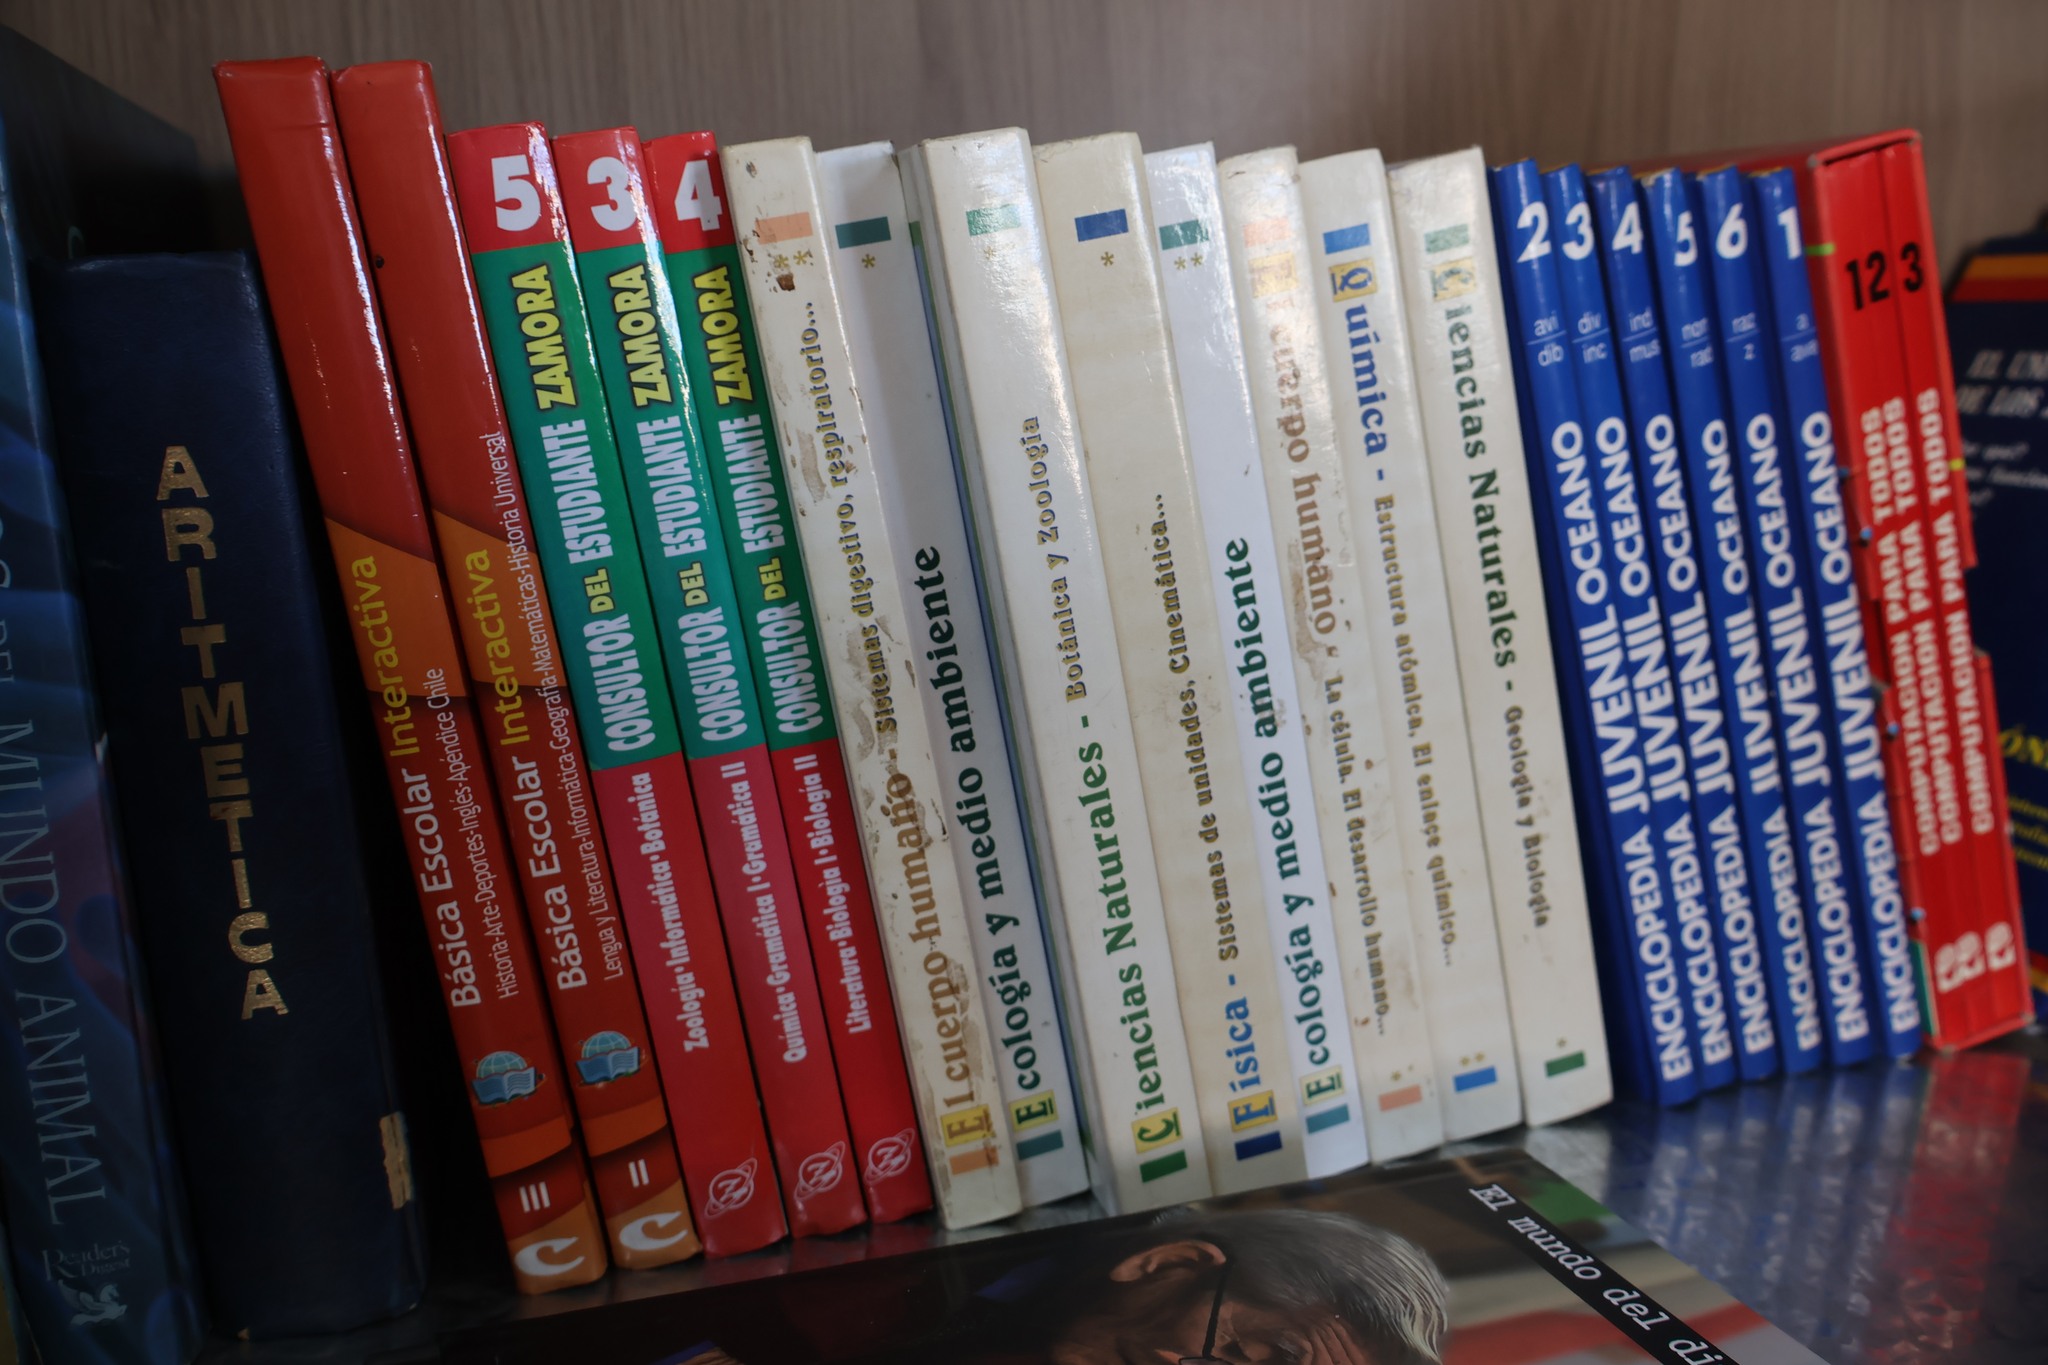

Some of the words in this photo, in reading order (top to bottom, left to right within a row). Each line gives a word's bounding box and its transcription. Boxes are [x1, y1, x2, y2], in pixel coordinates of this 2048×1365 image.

[492, 155, 541, 231] 5
[587, 152, 638, 231] 3
[675, 160, 721, 230] 4
[1518, 202, 1550, 262] 2
[1563, 202, 1593, 260] 3
[1613, 203, 1642, 253] 4
[1675, 212, 1697, 267] 5
[1717, 204, 1746, 258] 6
[1779, 208, 1800, 258] 1
[1901, 242, 1923, 292] 3
[512, 265, 575, 409] ZAMORA
[610, 265, 671, 406] ZAMORA
[694, 267, 752, 404] ZAMORA
[800, 303, 850, 487] respiratorio...
[1335, 268, 1387, 456] Química
[1435, 267, 1487, 459] Ciencias
[479, 431, 515, 506] Universal
[541, 420, 613, 563] ESTUDIANTE
[637, 416, 706, 556] ESTUDIANTE
[719, 415, 784, 553] ESTUDIANTE
[1020, 416, 1059, 545] Zoología
[1596, 418, 1649, 596] OCEANO
[1646, 415, 1696, 591] OCEANO
[1703, 420, 1747, 594] OCEANO
[1747, 414, 1794, 587] OCEANO
[1802, 412, 1850, 583] OCEANO
[1863, 409, 1892, 522] TODOS
[1883, 399, 1915, 512] TODOS
[1918, 390, 1949, 502] TODOS
[837, 495, 874, 617] digestivo,
[1047, 554, 1069, 569] y
[1293, 474, 1335, 634] humano
[1375, 495, 1407, 626] Estructura
[1470, 470, 1517, 667] Naturales
[1552, 422, 1607, 604] OCEANO
[1901, 523, 1929, 611] PARA
[1935, 513, 1962, 602] PARA
[585, 569, 613, 613] DEL
[680, 563, 708, 606] DEL
[759, 559, 785, 600] DEL
[1052, 577, 1087, 702] Botánica
[1151, 495, 1190, 674] Cinemática...
[1225, 538, 1277, 737] ambiente
[1878, 533, 1906, 622] PARA
[352, 556, 419, 755] Interactiva
[423, 669, 449, 708] Chile
[465, 549, 529, 744] Interactiva
[584, 614, 655, 750] CONSULTOR
[678, 607, 747, 740] CONSULTOR
[757, 602, 822, 732] CONSULTOR
[862, 625, 897, 733] Sistemas
[915, 547, 975, 752] ambiente
[1325, 676, 1343, 704] La
[1396, 634, 1423, 737] atómica,
[1580, 605, 1649, 812] JUVENIL
[1624, 597, 1689, 801] JUVENIL
[1671, 592, 1733, 793] JUVENIL
[1726, 608, 1779, 793] JUVENIL
[1769, 588, 1830, 785] JUVENIL
[1824, 585, 1882, 779] JUVENIL
[155, 445, 289, 1021] ARITMETICA
[721, 762, 745, 777] II
[794, 755, 817, 770] II
[1180, 681, 1212, 806] unidades,
[1330, 711, 1354, 783] célula.
[1414, 743, 1432, 766] El
[1505, 706, 1533, 808] Geología
[402, 769, 453, 892] Escolar
[512, 756, 561, 877] Escolar
[884, 772, 941, 942] humano
[956, 768, 1003, 898] medio
[1079, 743, 1136, 955] Naturales
[1199, 814, 1218, 843] de
[1259, 753, 1300, 879] medio
[1343, 790, 1362, 811] El
[1418, 774, 1441, 847] enlace
[1517, 816, 1533, 826] y
[596, 917, 615, 926] y
[986, 914, 1019, 935] y
[1208, 851, 1238, 961] Sistemas
[1283, 895, 1314, 915] y
[1347, 818, 1377, 927] desarrollo
[1524, 834, 1550, 926] Biología
[1709, 807, 1773, 1053] ENCICLOPEDIA
[1763, 807, 1819, 1050] ENCICLOPEDIA
[1804, 799, 1868, 1041] ENCICLOPEDIA
[1859, 793, 1919, 1032] ENCICLOPEDIA
[437, 901, 481, 1006] Básica
[545, 885, 587, 989] Básica
[599, 927, 623, 980] Lengua
[1365, 933, 1389, 1034] humano...
[1623, 827, 1691, 1080] ENCICLOPEDIA
[1664, 814, 1731, 1064] ENCICLOPEDIA
[924, 952, 971, 1081] cuerpo
[989, 945, 1055, 1124] Ecología
[1119, 964, 1176, 1144] Ciencias
[1226, 998, 1271, 1125] Física
[1285, 925, 1341, 1098] Ecología
[16, 991, 106, 1224] ANIMAL
[944, 1091, 989, 1139] El
[1468, 1184, 1516, 1211] El
[1508, 1216, 1602, 1280] mundo
[1603, 1288, 1671, 1331] del
